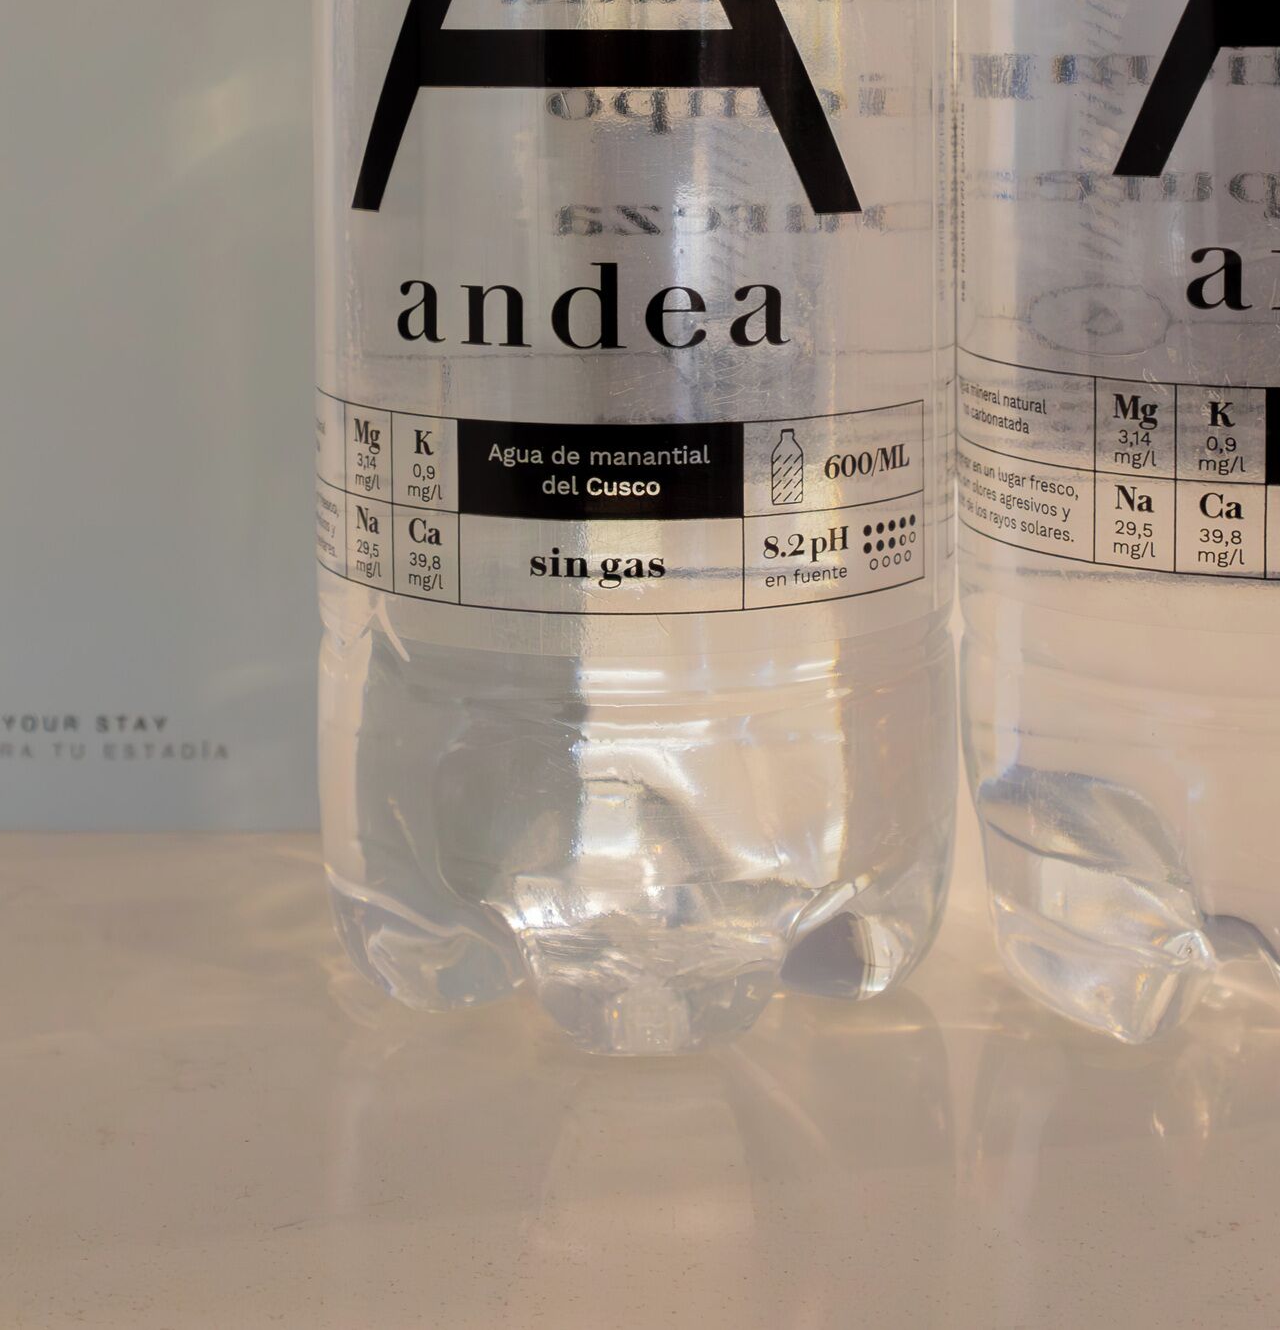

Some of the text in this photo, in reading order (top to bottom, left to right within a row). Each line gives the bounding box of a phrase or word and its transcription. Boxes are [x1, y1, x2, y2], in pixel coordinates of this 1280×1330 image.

[396, 262, 792, 350] andea
[1003, 391, 1048, 415] natural
[1112, 393, 1158, 429] Mg
[1207, 401, 1235, 429] K
[971, 405, 1030, 435] carbonatada
[353, 418, 381, 455] Mg
[414, 429, 434, 456] K
[1118, 429, 1151, 448] 3,14
[1205, 435, 1237, 455] 0,9
[356, 452, 377, 471] 3,14
[488, 443, 711, 467] Agua de manantial
[824, 442, 910, 481] 600/ML
[1113, 448, 1158, 471] mg/l
[1198, 454, 1246, 476] mg/l
[355, 473, 381, 492] mg/l
[412, 463, 436, 481] 0,9
[983, 463, 995, 478] un
[998, 466, 1026, 489] lugar
[1029, 474, 1079, 501] fresco,
[407, 484, 442, 502] mg/l
[542, 476, 661, 498] del Cusco
[999, 490, 1057, 517] agresivos
[1061, 506, 1071, 522] y
[1115, 485, 1155, 514] Na
[1199, 492, 1244, 521] Ca
[355, 505, 380, 535] Na
[408, 517, 443, 547] Ca
[989, 510, 1017, 529] rayos
[1020, 519, 1075, 543] solares.
[1115, 519, 1154, 541] 29,5
[356, 538, 380, 559] 29,5
[1198, 527, 1243, 547] 39,8
[409, 552, 441, 571] 39,8
[1112, 540, 1156, 562] mg/l
[1197, 546, 1245, 570] mg/l
[356, 558, 382, 579] mg/l
[529, 547, 667, 588] sin gas
[765, 564, 848, 588] en fuente
[408, 573, 444, 592] mg/l
[3, 715, 80, 733] YOUR
[95, 716, 168, 733] STAY
[53, 743, 86, 760] TU
